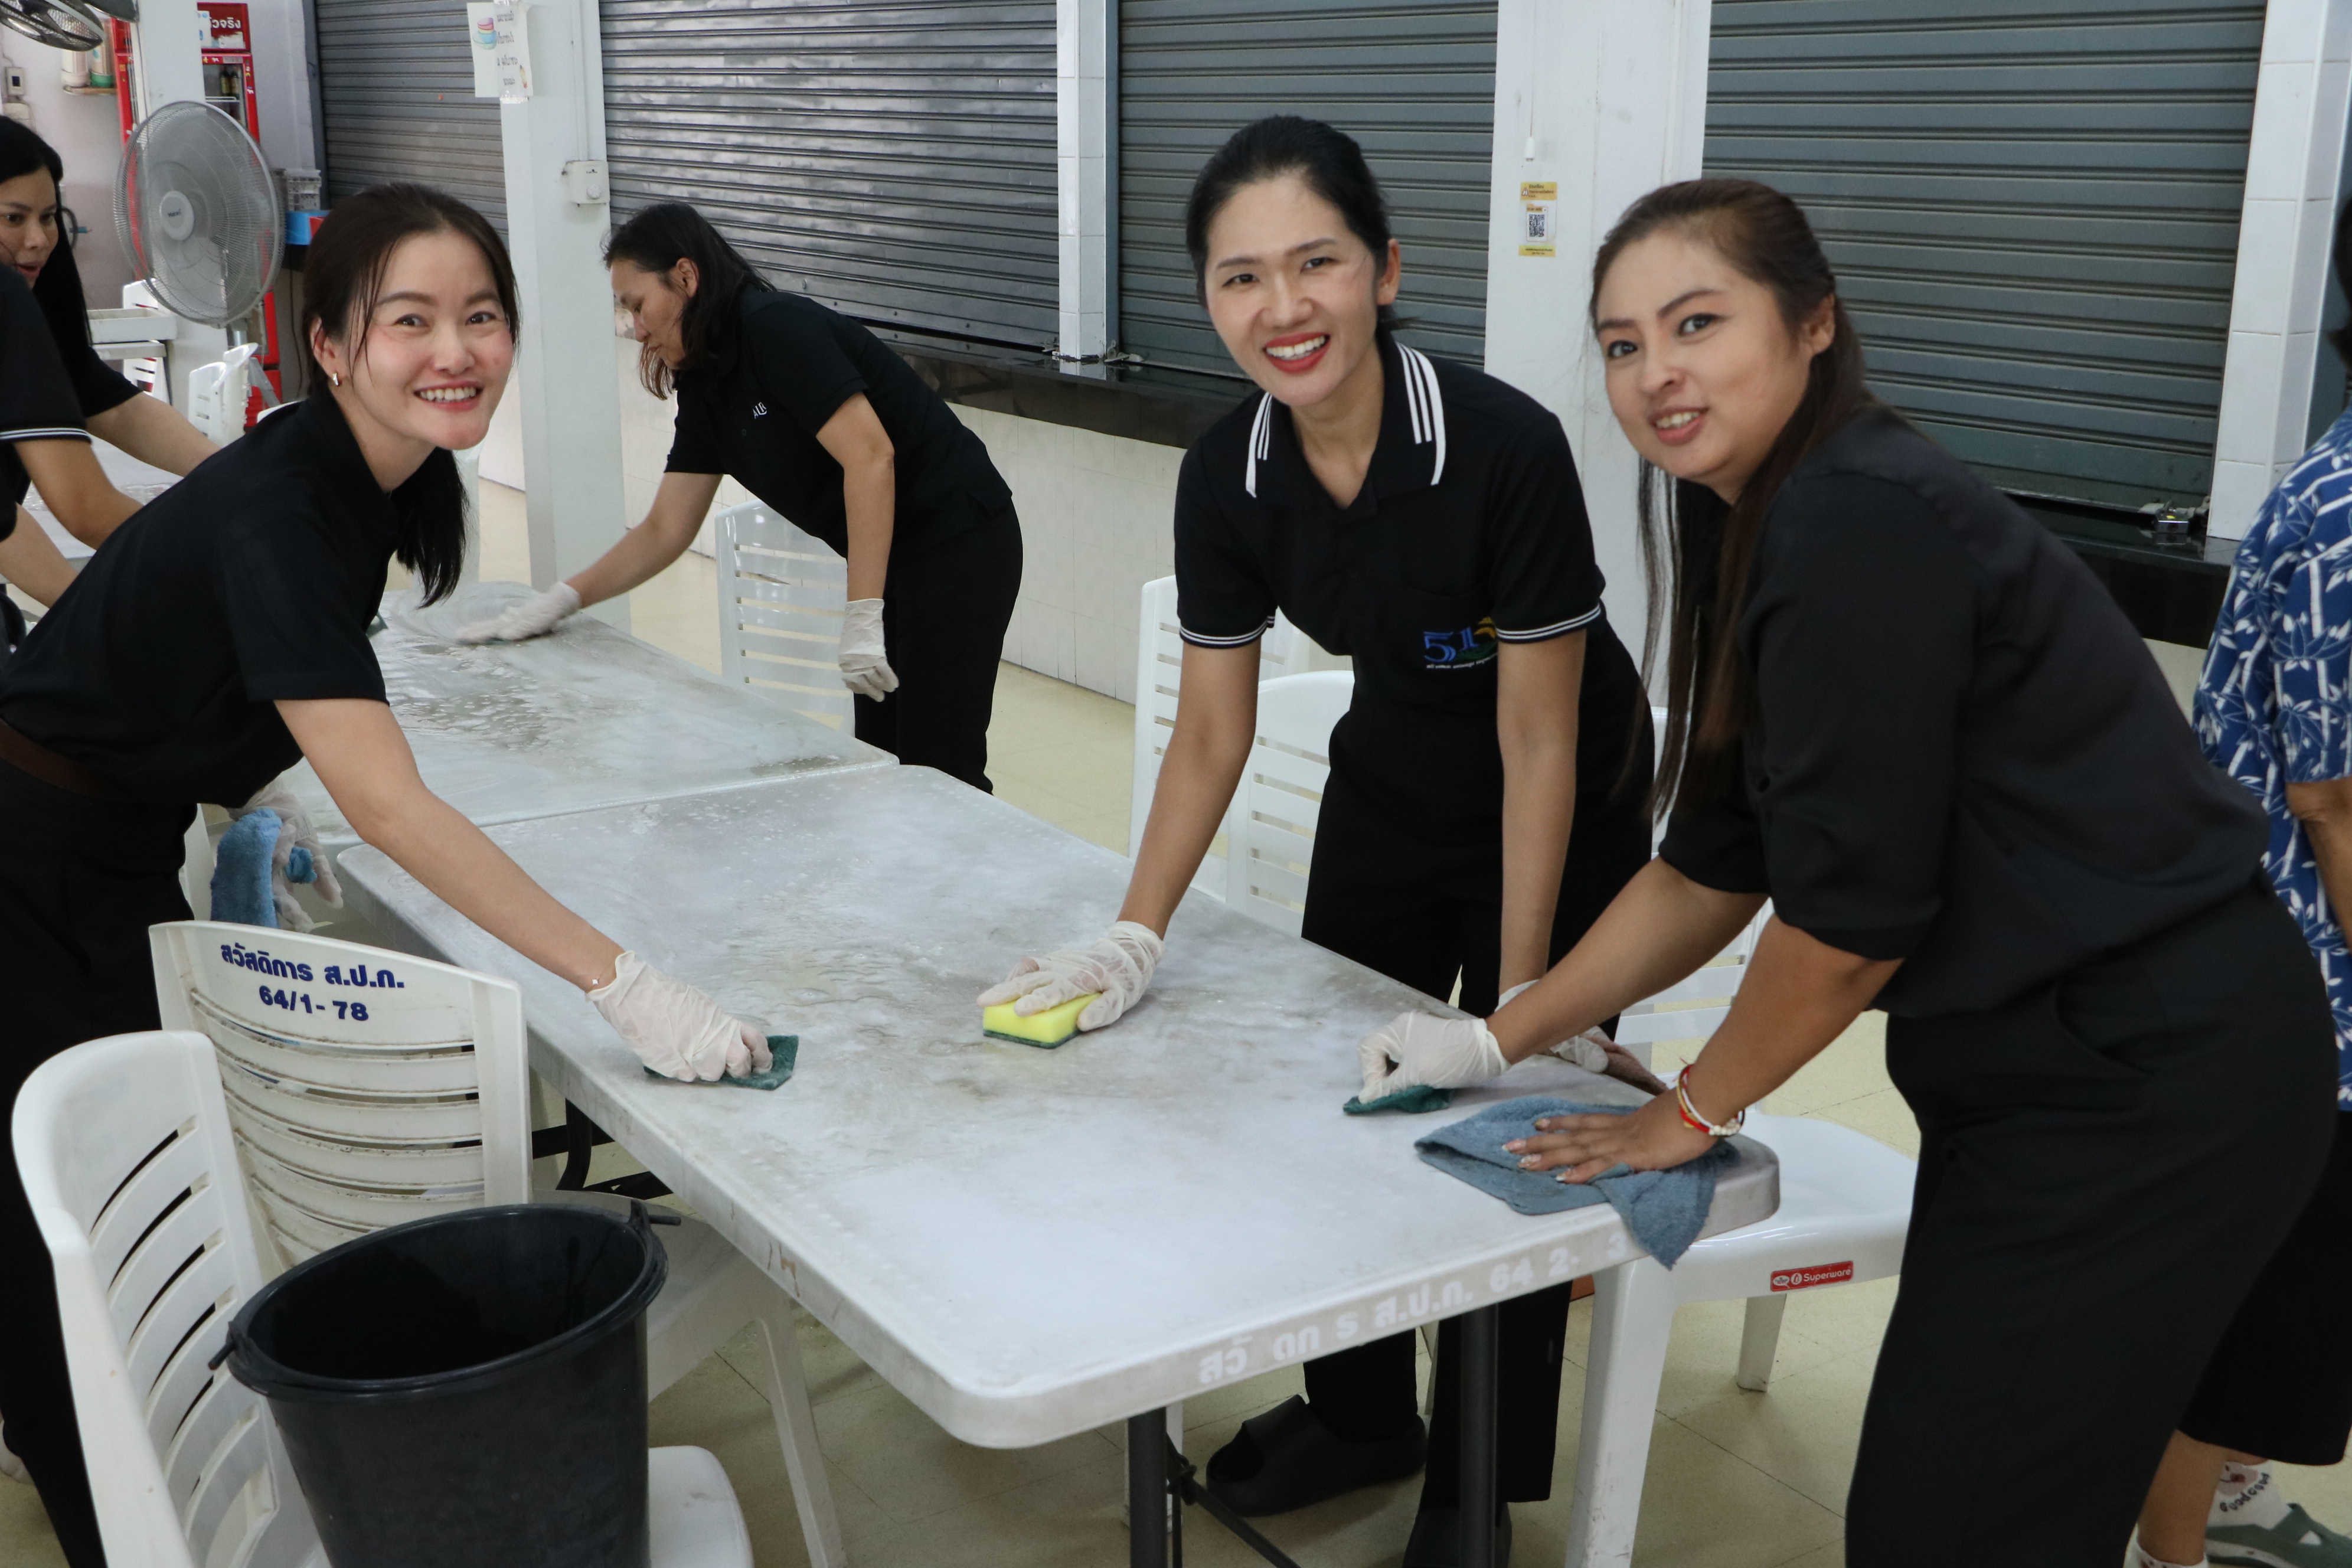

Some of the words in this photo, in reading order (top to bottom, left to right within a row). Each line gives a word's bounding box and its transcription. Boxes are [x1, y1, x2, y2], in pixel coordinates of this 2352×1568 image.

[210, 17, 241, 28] วจริง
[221, 942, 313, 982] สวัสดิการ
[324, 964, 405, 988] ส.ป.ก.
[1803, 1269, 1851, 1282] Superware
[1374, 1279, 1474, 1328] ส.ป.ก.
